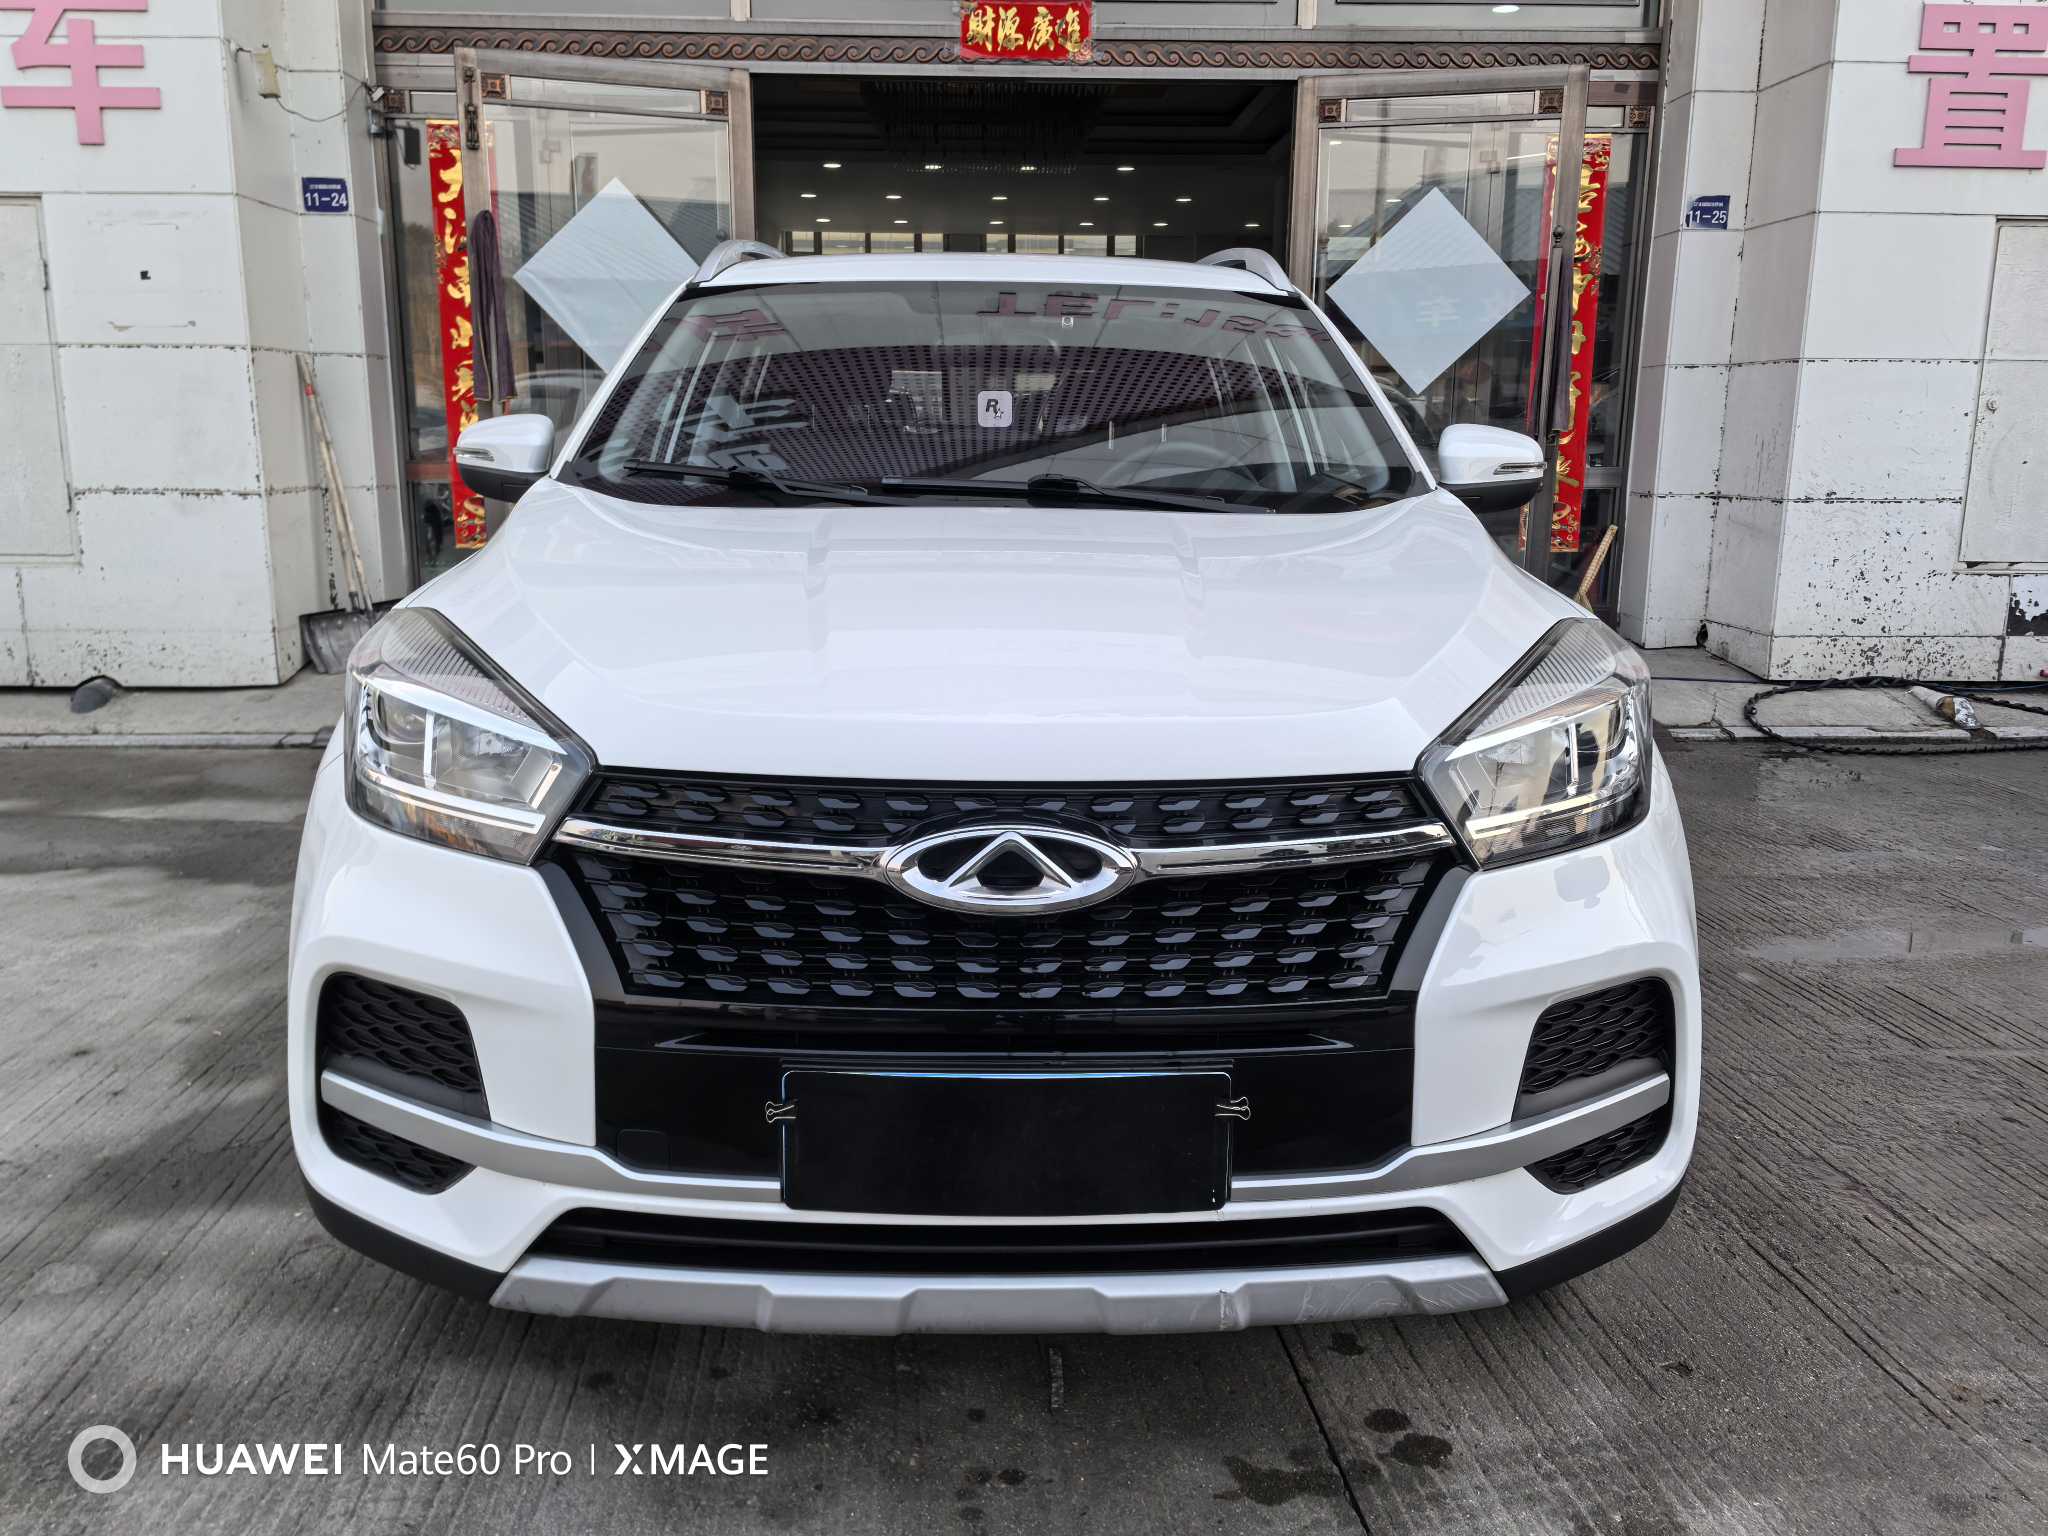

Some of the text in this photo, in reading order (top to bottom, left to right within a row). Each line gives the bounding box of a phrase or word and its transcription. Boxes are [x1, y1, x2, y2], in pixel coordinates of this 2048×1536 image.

[1893, 3, 2048, 169] 置
[305, 192, 347, 207] 11-24
[1688, 210, 1728, 224] 11-25
